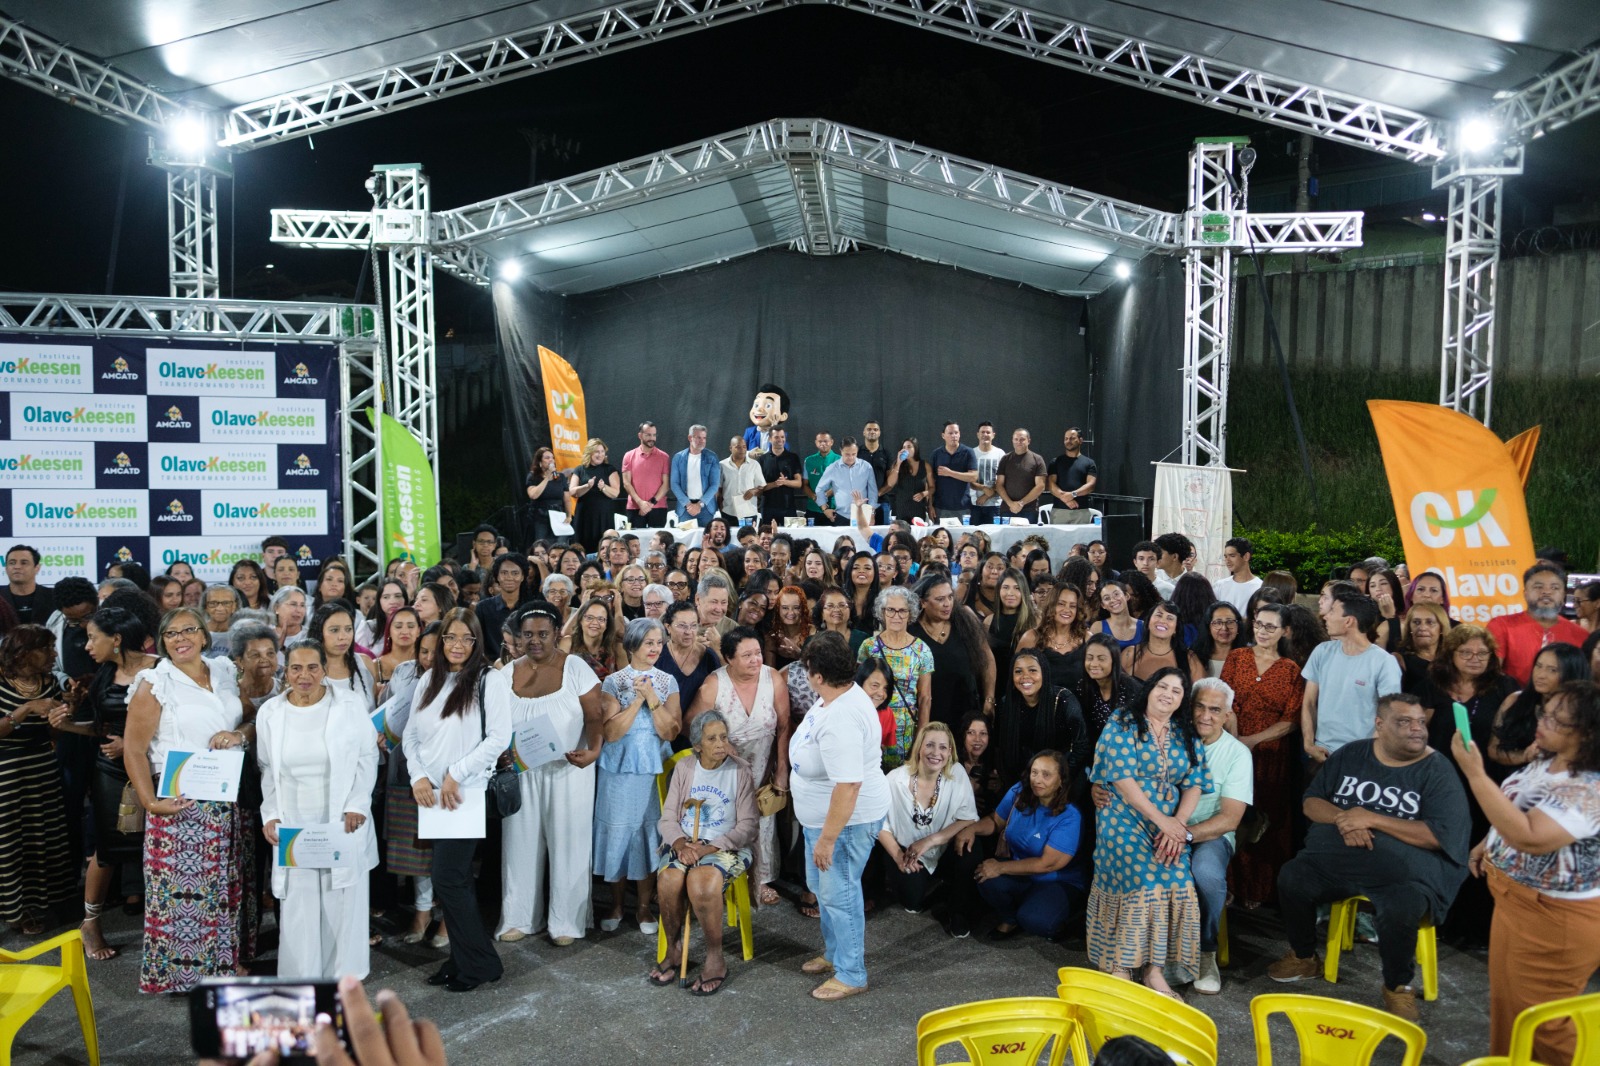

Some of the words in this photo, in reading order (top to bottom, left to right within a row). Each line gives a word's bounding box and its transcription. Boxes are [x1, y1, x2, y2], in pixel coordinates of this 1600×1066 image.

[101, 372, 139, 380] AMCATD
[159, 380, 236, 389] TRANSFORMANDO
[240, 382, 265, 390] VIDAS
[283, 377, 318, 385] AMCATD
[155, 420, 192, 429] AMCATD
[23, 425, 105, 433] TRANSFORMANDO
[110, 426, 137, 434] VIDAS
[211, 428, 286, 436] TRANSFORMANDO
[291, 429, 316, 437] VIDAS
[103, 467, 141, 475] AMCATD
[285, 468, 320, 476] AMCATD
[157, 514, 193, 522] AMCATD
[1410, 488, 1511, 548] OK
[1424, 566, 1520, 597] lavo
[1335, 775, 1421, 815] BOSS
[1315, 1023, 1357, 1040] SKOL
[990, 1041, 1027, 1055] SKOL
